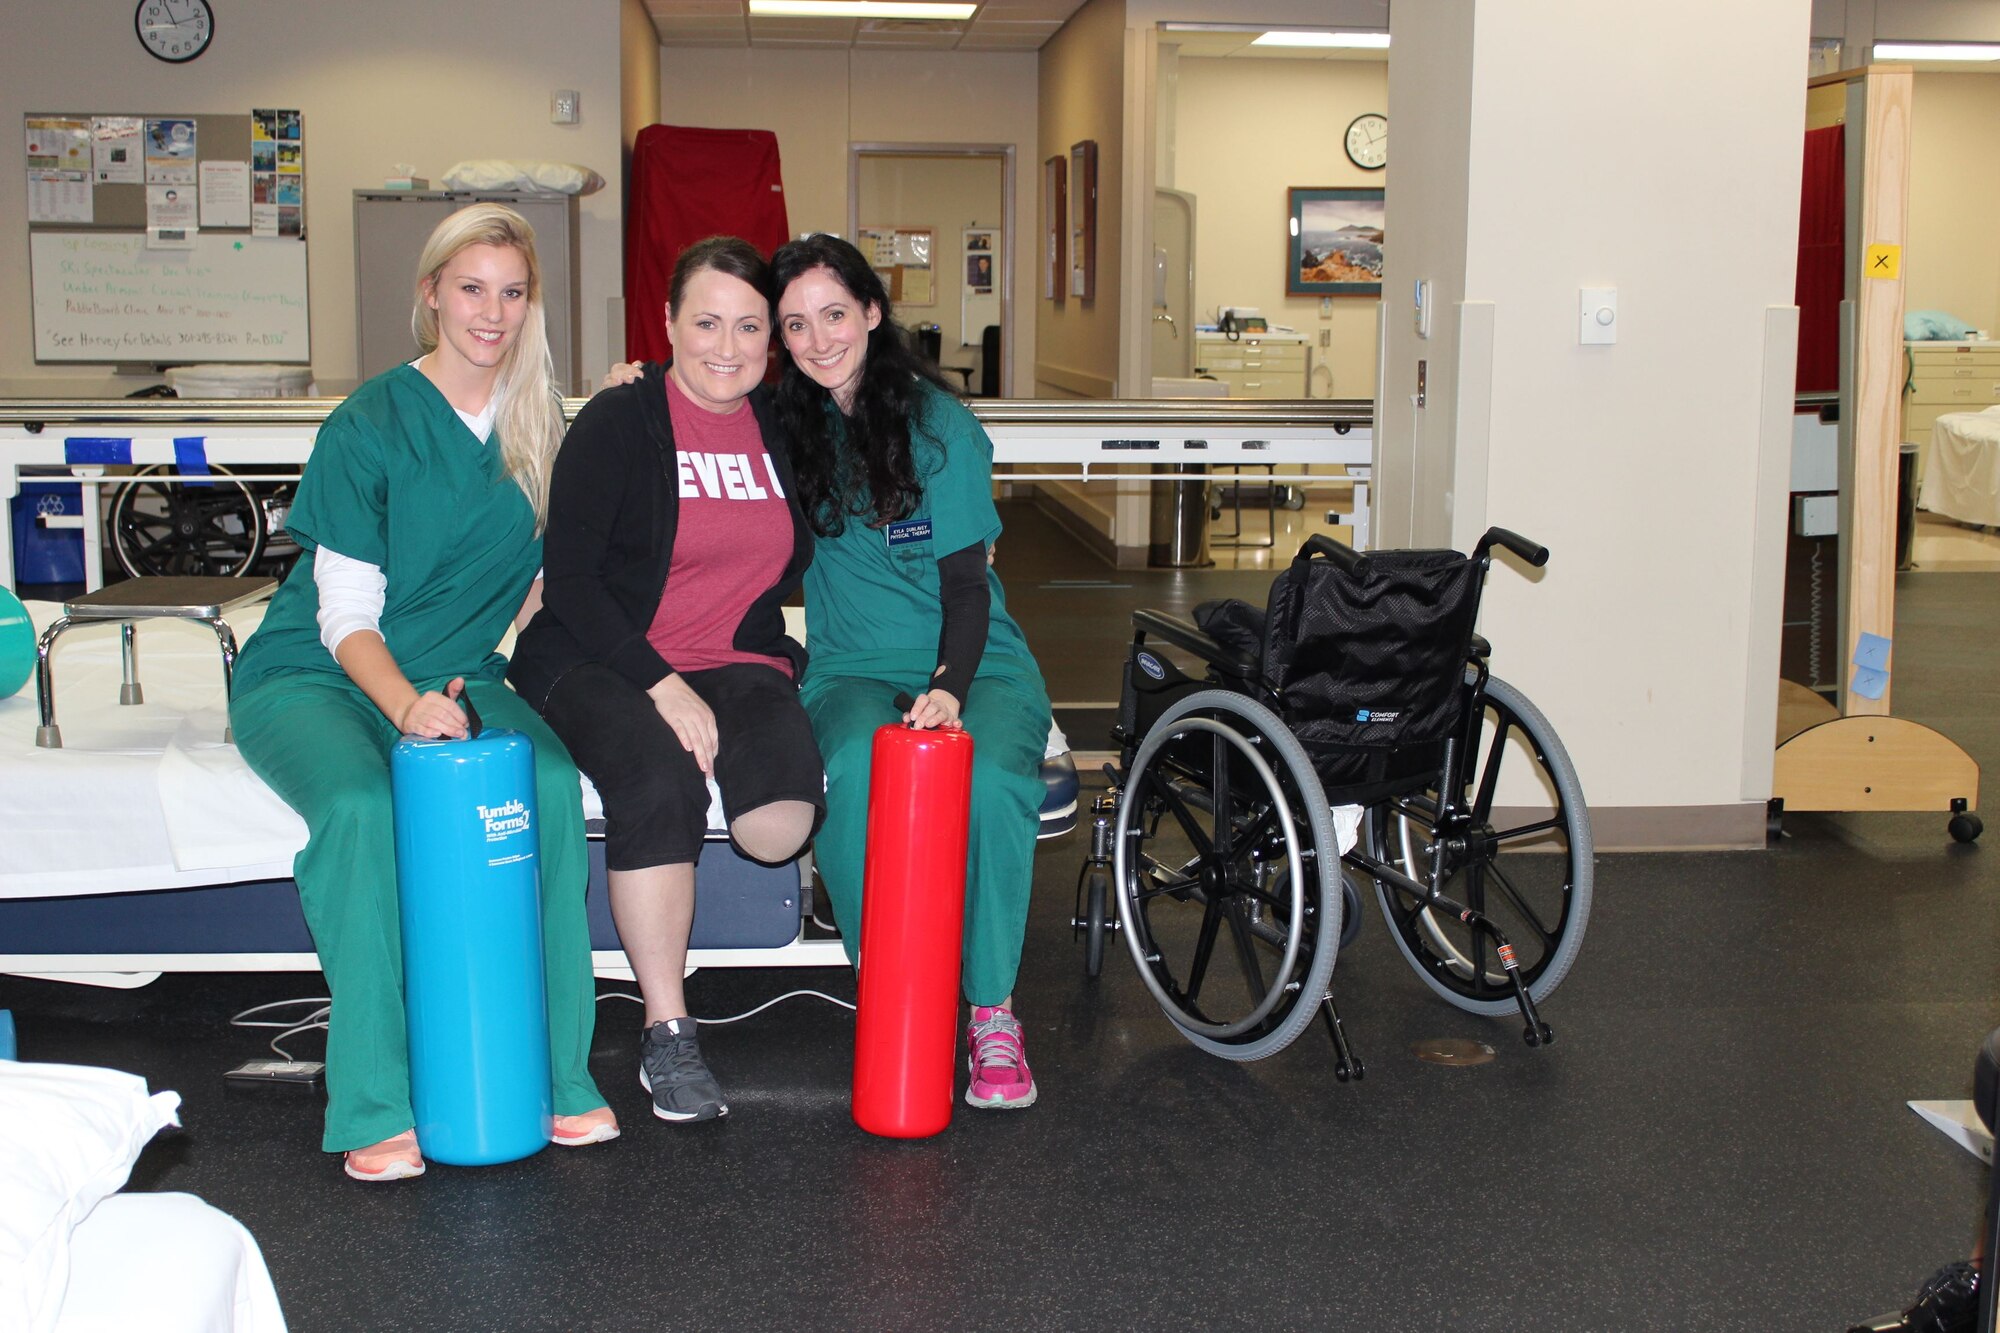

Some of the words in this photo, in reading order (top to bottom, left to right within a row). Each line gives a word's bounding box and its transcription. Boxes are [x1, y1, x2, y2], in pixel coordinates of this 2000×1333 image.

[149, 7, 160, 16] 10
[193, 8, 201, 18] 2
[196, 20, 204, 29] 3
[150, 32, 157, 40] 8
[193, 33, 200, 41] 4
[160, 41, 166, 50] 7
[171, 45, 179, 54] 6
[185, 42, 191, 51] 5
[890, 532, 910, 540] PHYSICAL
[1370, 711, 1400, 719] COMFORT
[476, 799, 524, 820] Tumble
